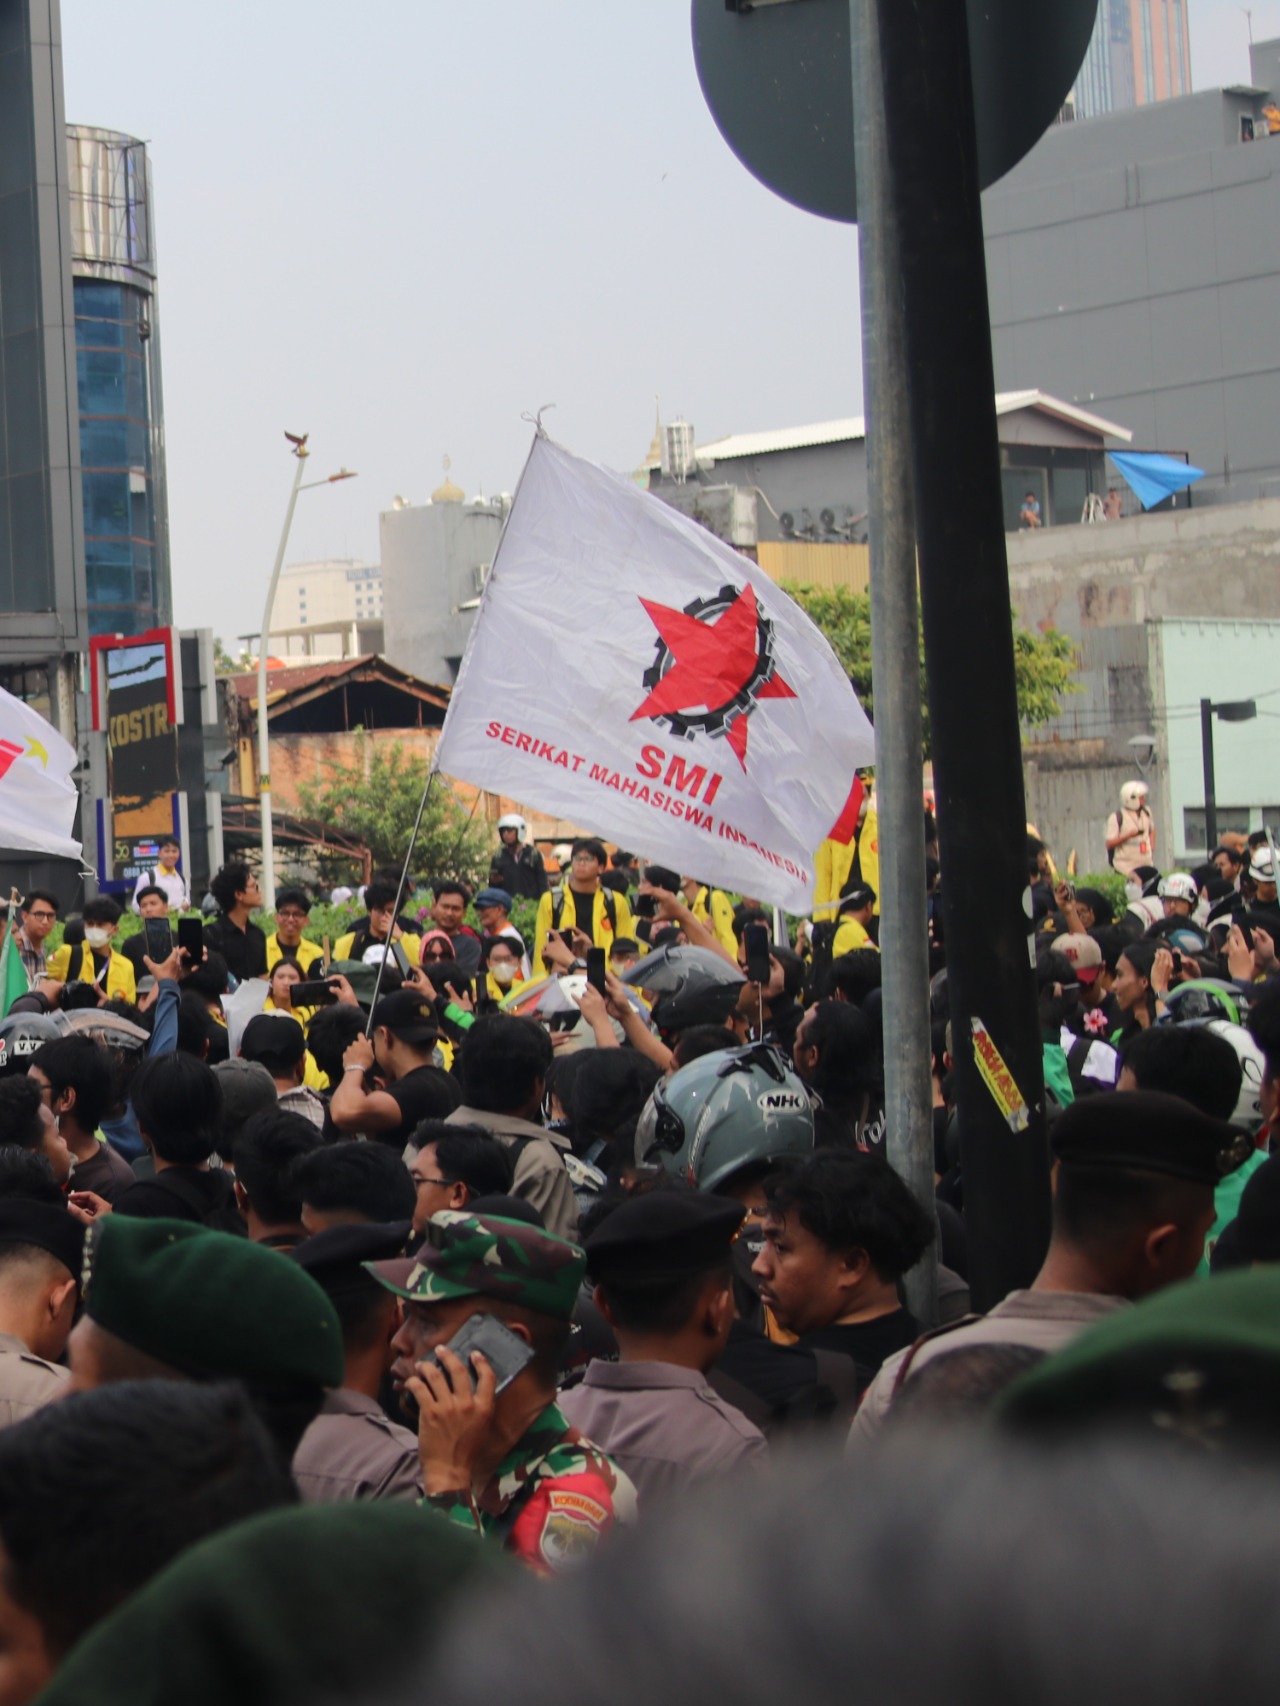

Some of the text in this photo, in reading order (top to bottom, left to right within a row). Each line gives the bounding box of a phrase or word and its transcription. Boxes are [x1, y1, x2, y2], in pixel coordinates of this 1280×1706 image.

[110, 703, 174, 748] KOSTR
[485, 721, 586, 772] SERIKAT
[588, 763, 714, 833] MAHASISWA
[635, 744, 723, 806] SMI
